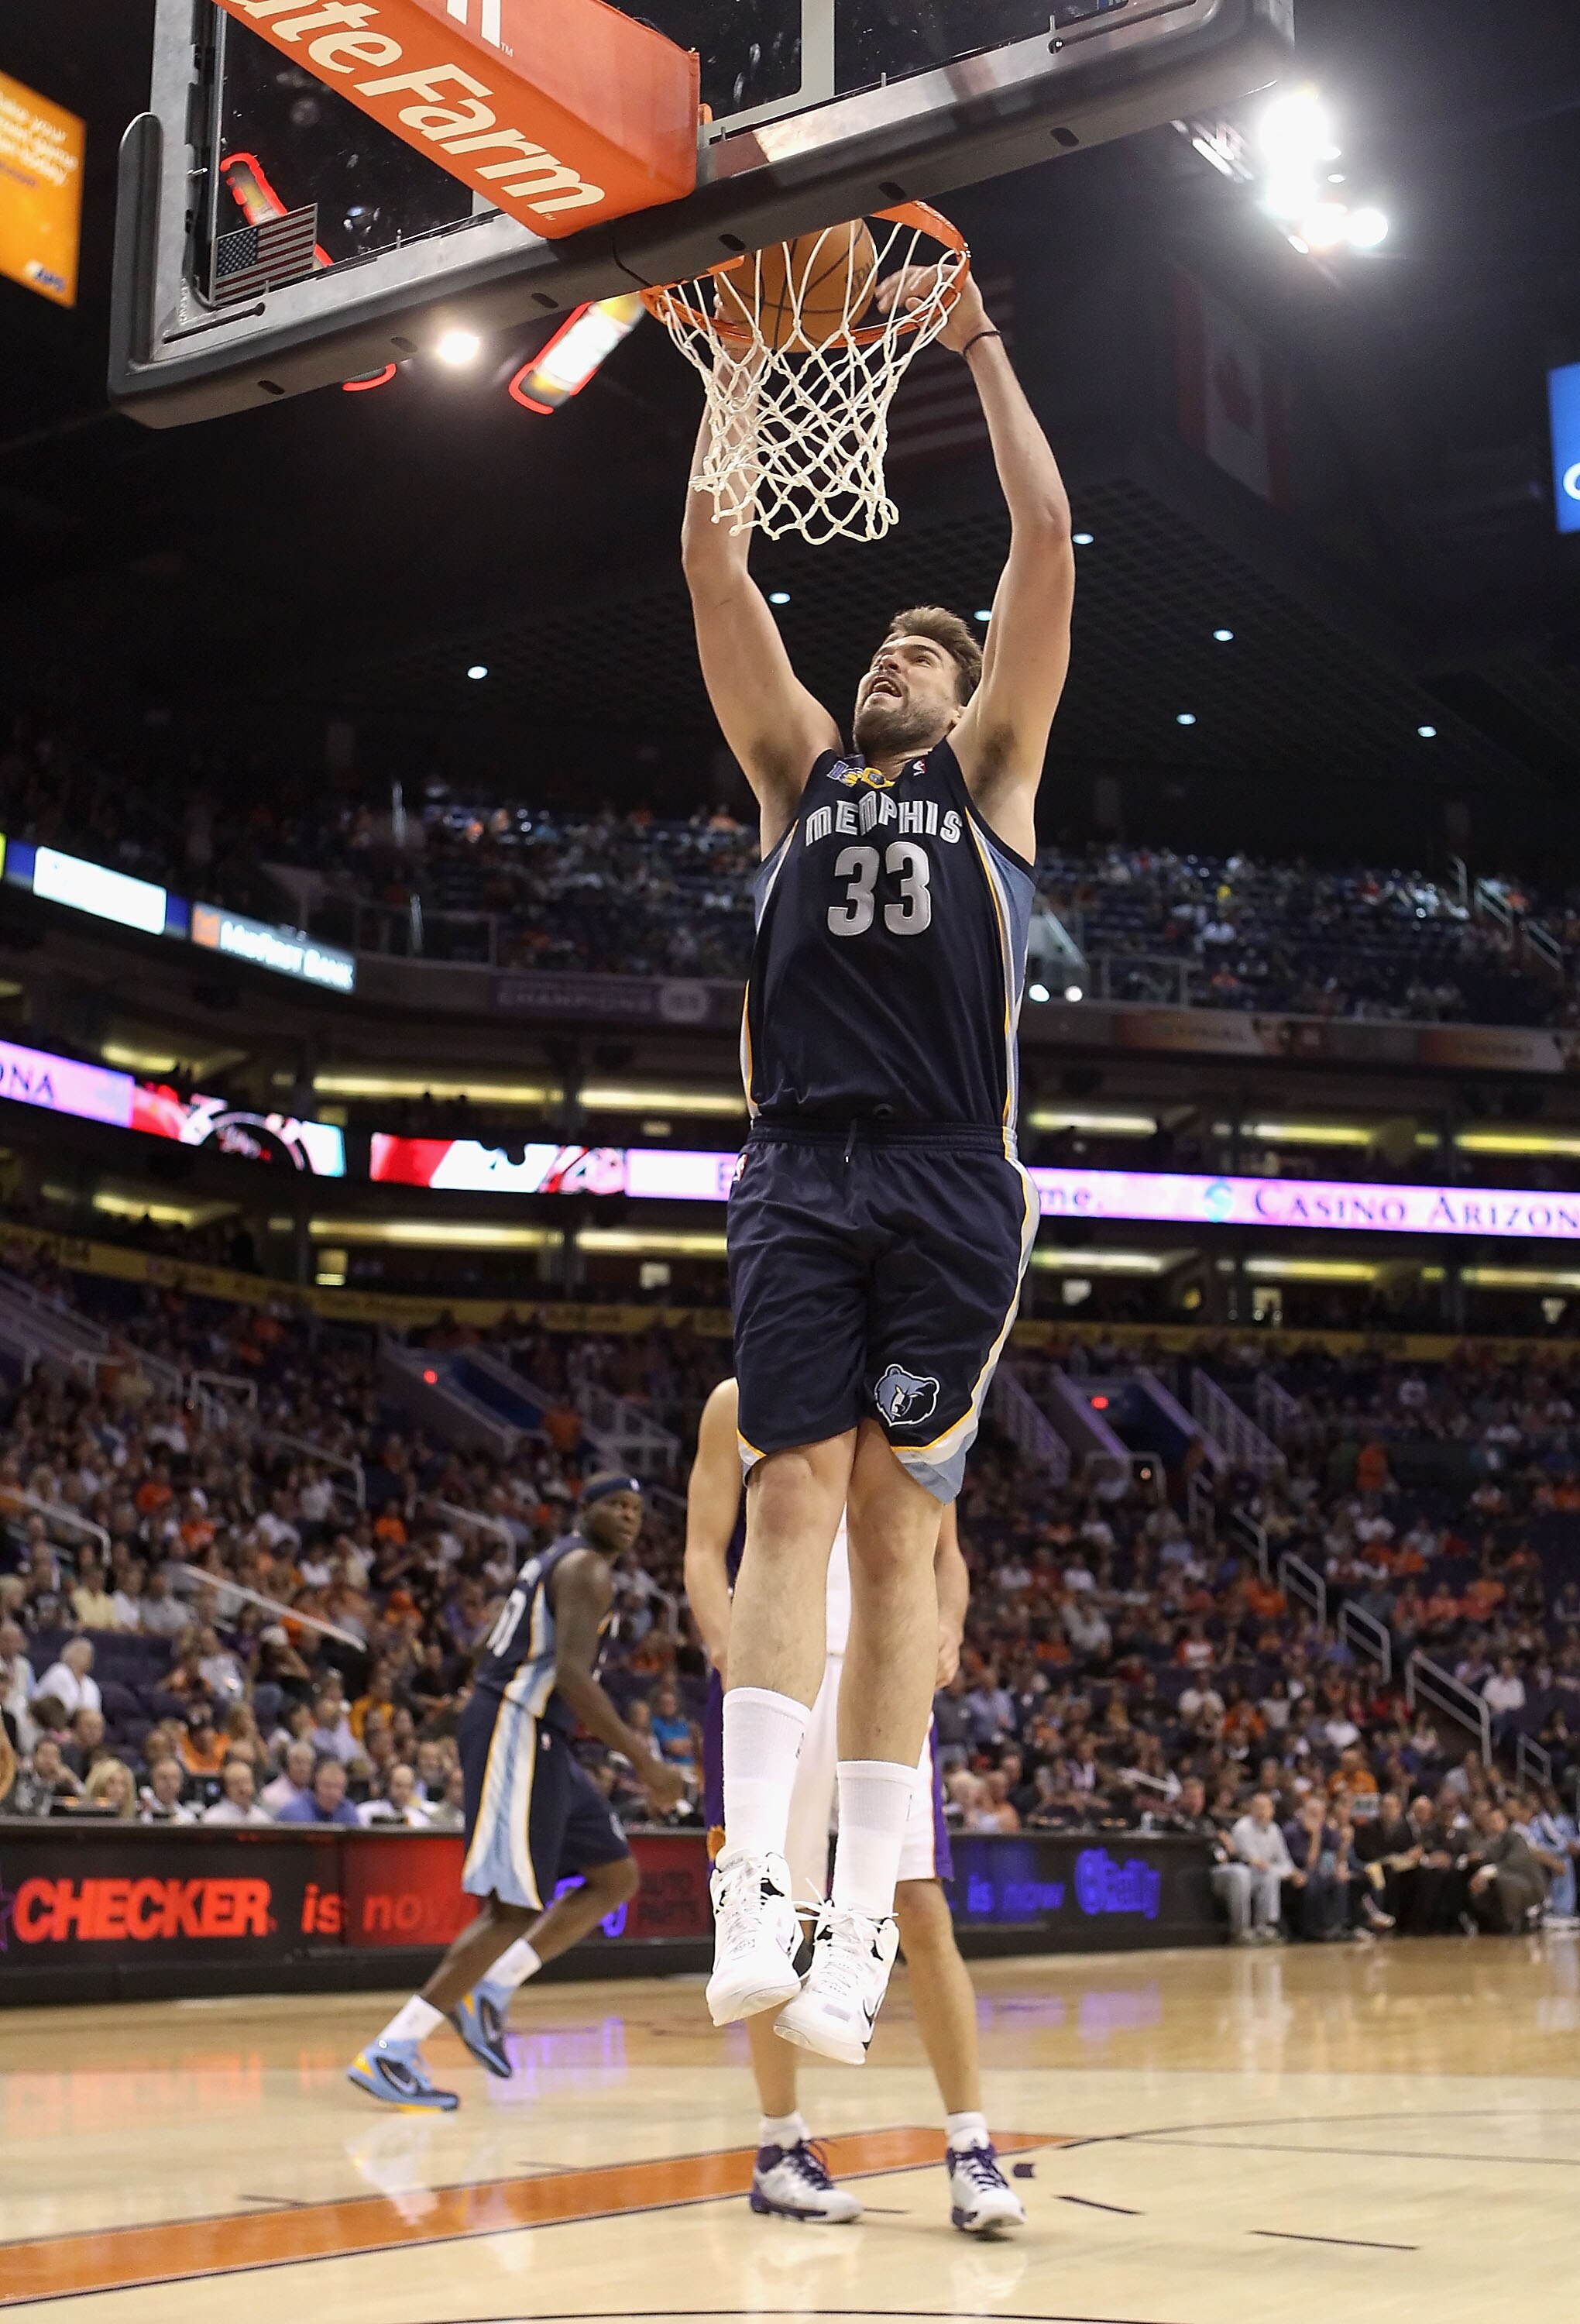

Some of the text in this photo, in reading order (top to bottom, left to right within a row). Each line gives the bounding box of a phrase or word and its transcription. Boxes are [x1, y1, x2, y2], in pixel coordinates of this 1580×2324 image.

[353, 63, 606, 215] Farm
[805, 791, 963, 847] MEMPHIS
[827, 841, 932, 937] 33
[0, 1064, 55, 1100] NA
[13, 1878, 271, 1943] CHECKER
[302, 1884, 342, 1933] is
[967, 1873, 992, 1913] is
